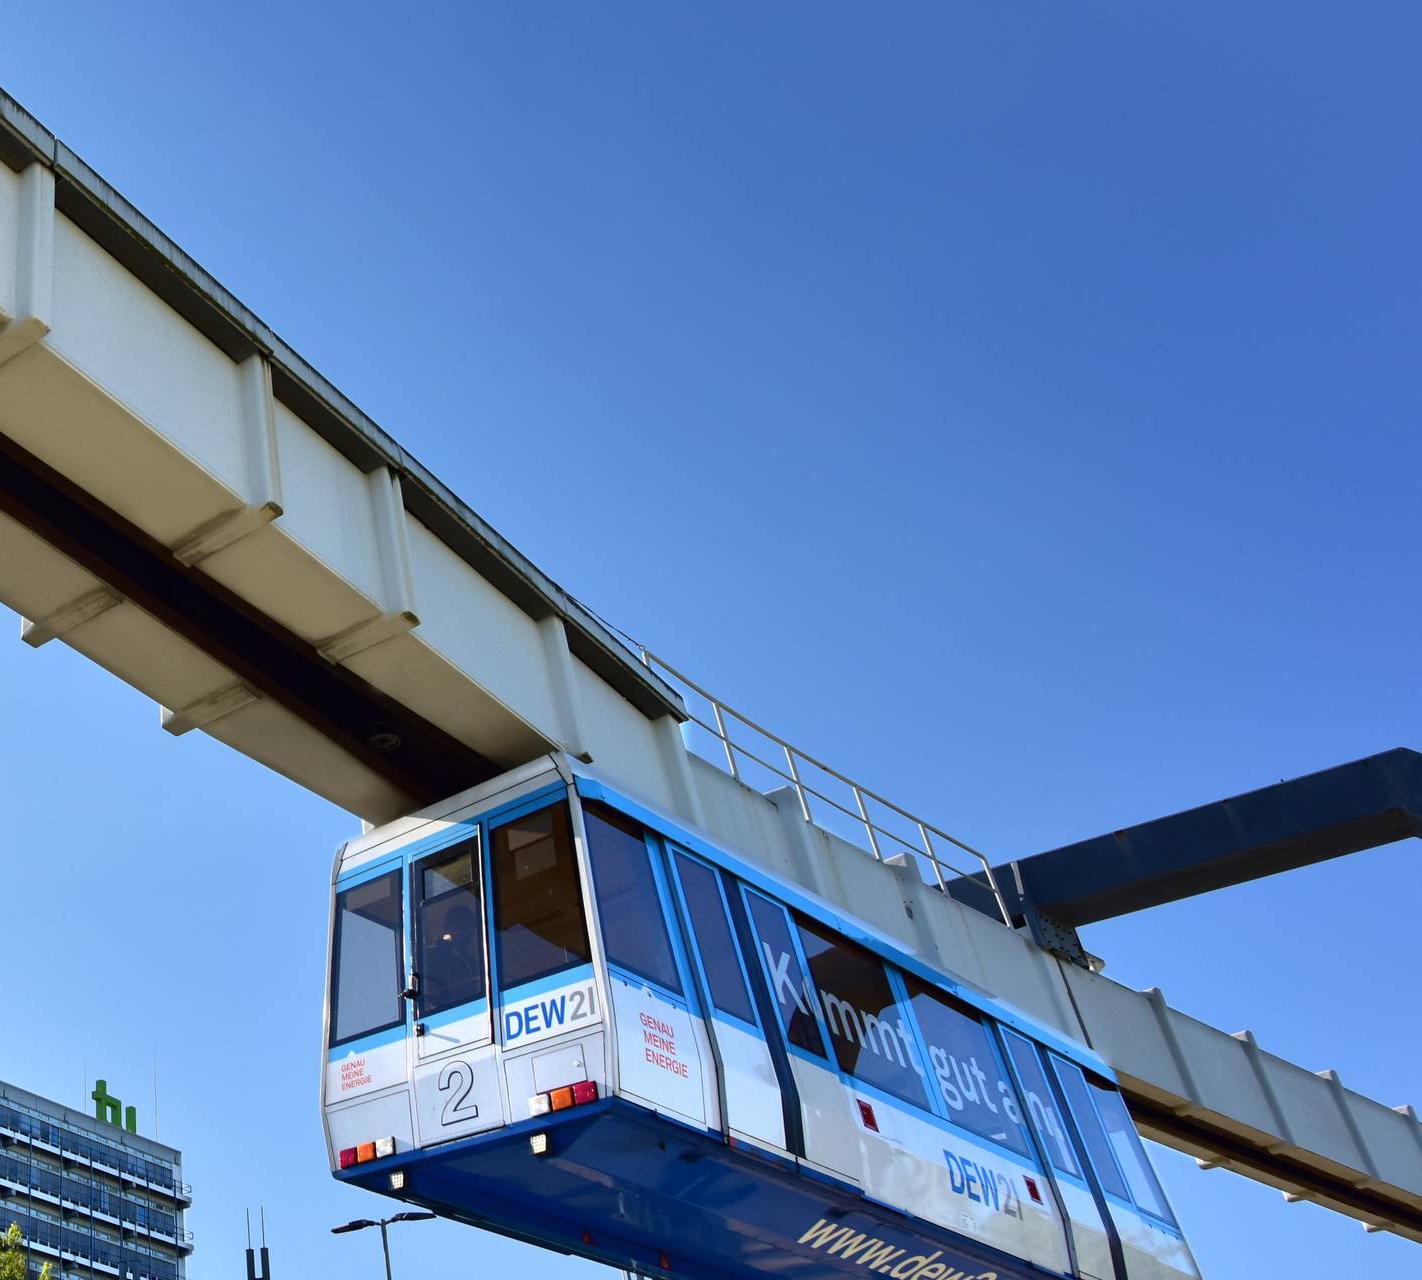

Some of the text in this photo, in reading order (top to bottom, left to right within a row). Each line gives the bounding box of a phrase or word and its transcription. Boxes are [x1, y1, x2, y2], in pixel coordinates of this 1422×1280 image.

[505, 987, 596, 1041] DEW21
[639, 1012, 675, 1038] GENAU
[642, 1029, 676, 1055] MEINE
[645, 1048, 689, 1078] ENERGIE
[341, 1058, 366, 1072] GENAU
[341, 1068, 364, 1081] MEINE
[341, 1075, 372, 1091] ENERGIE
[929, 1045, 999, 1111] gut
[92, 1079, 137, 1133] tu
[438, 1060, 479, 1127] 2
[943, 1149, 1024, 1221] DEW21
[796, 1218, 998, 1280] www.de
